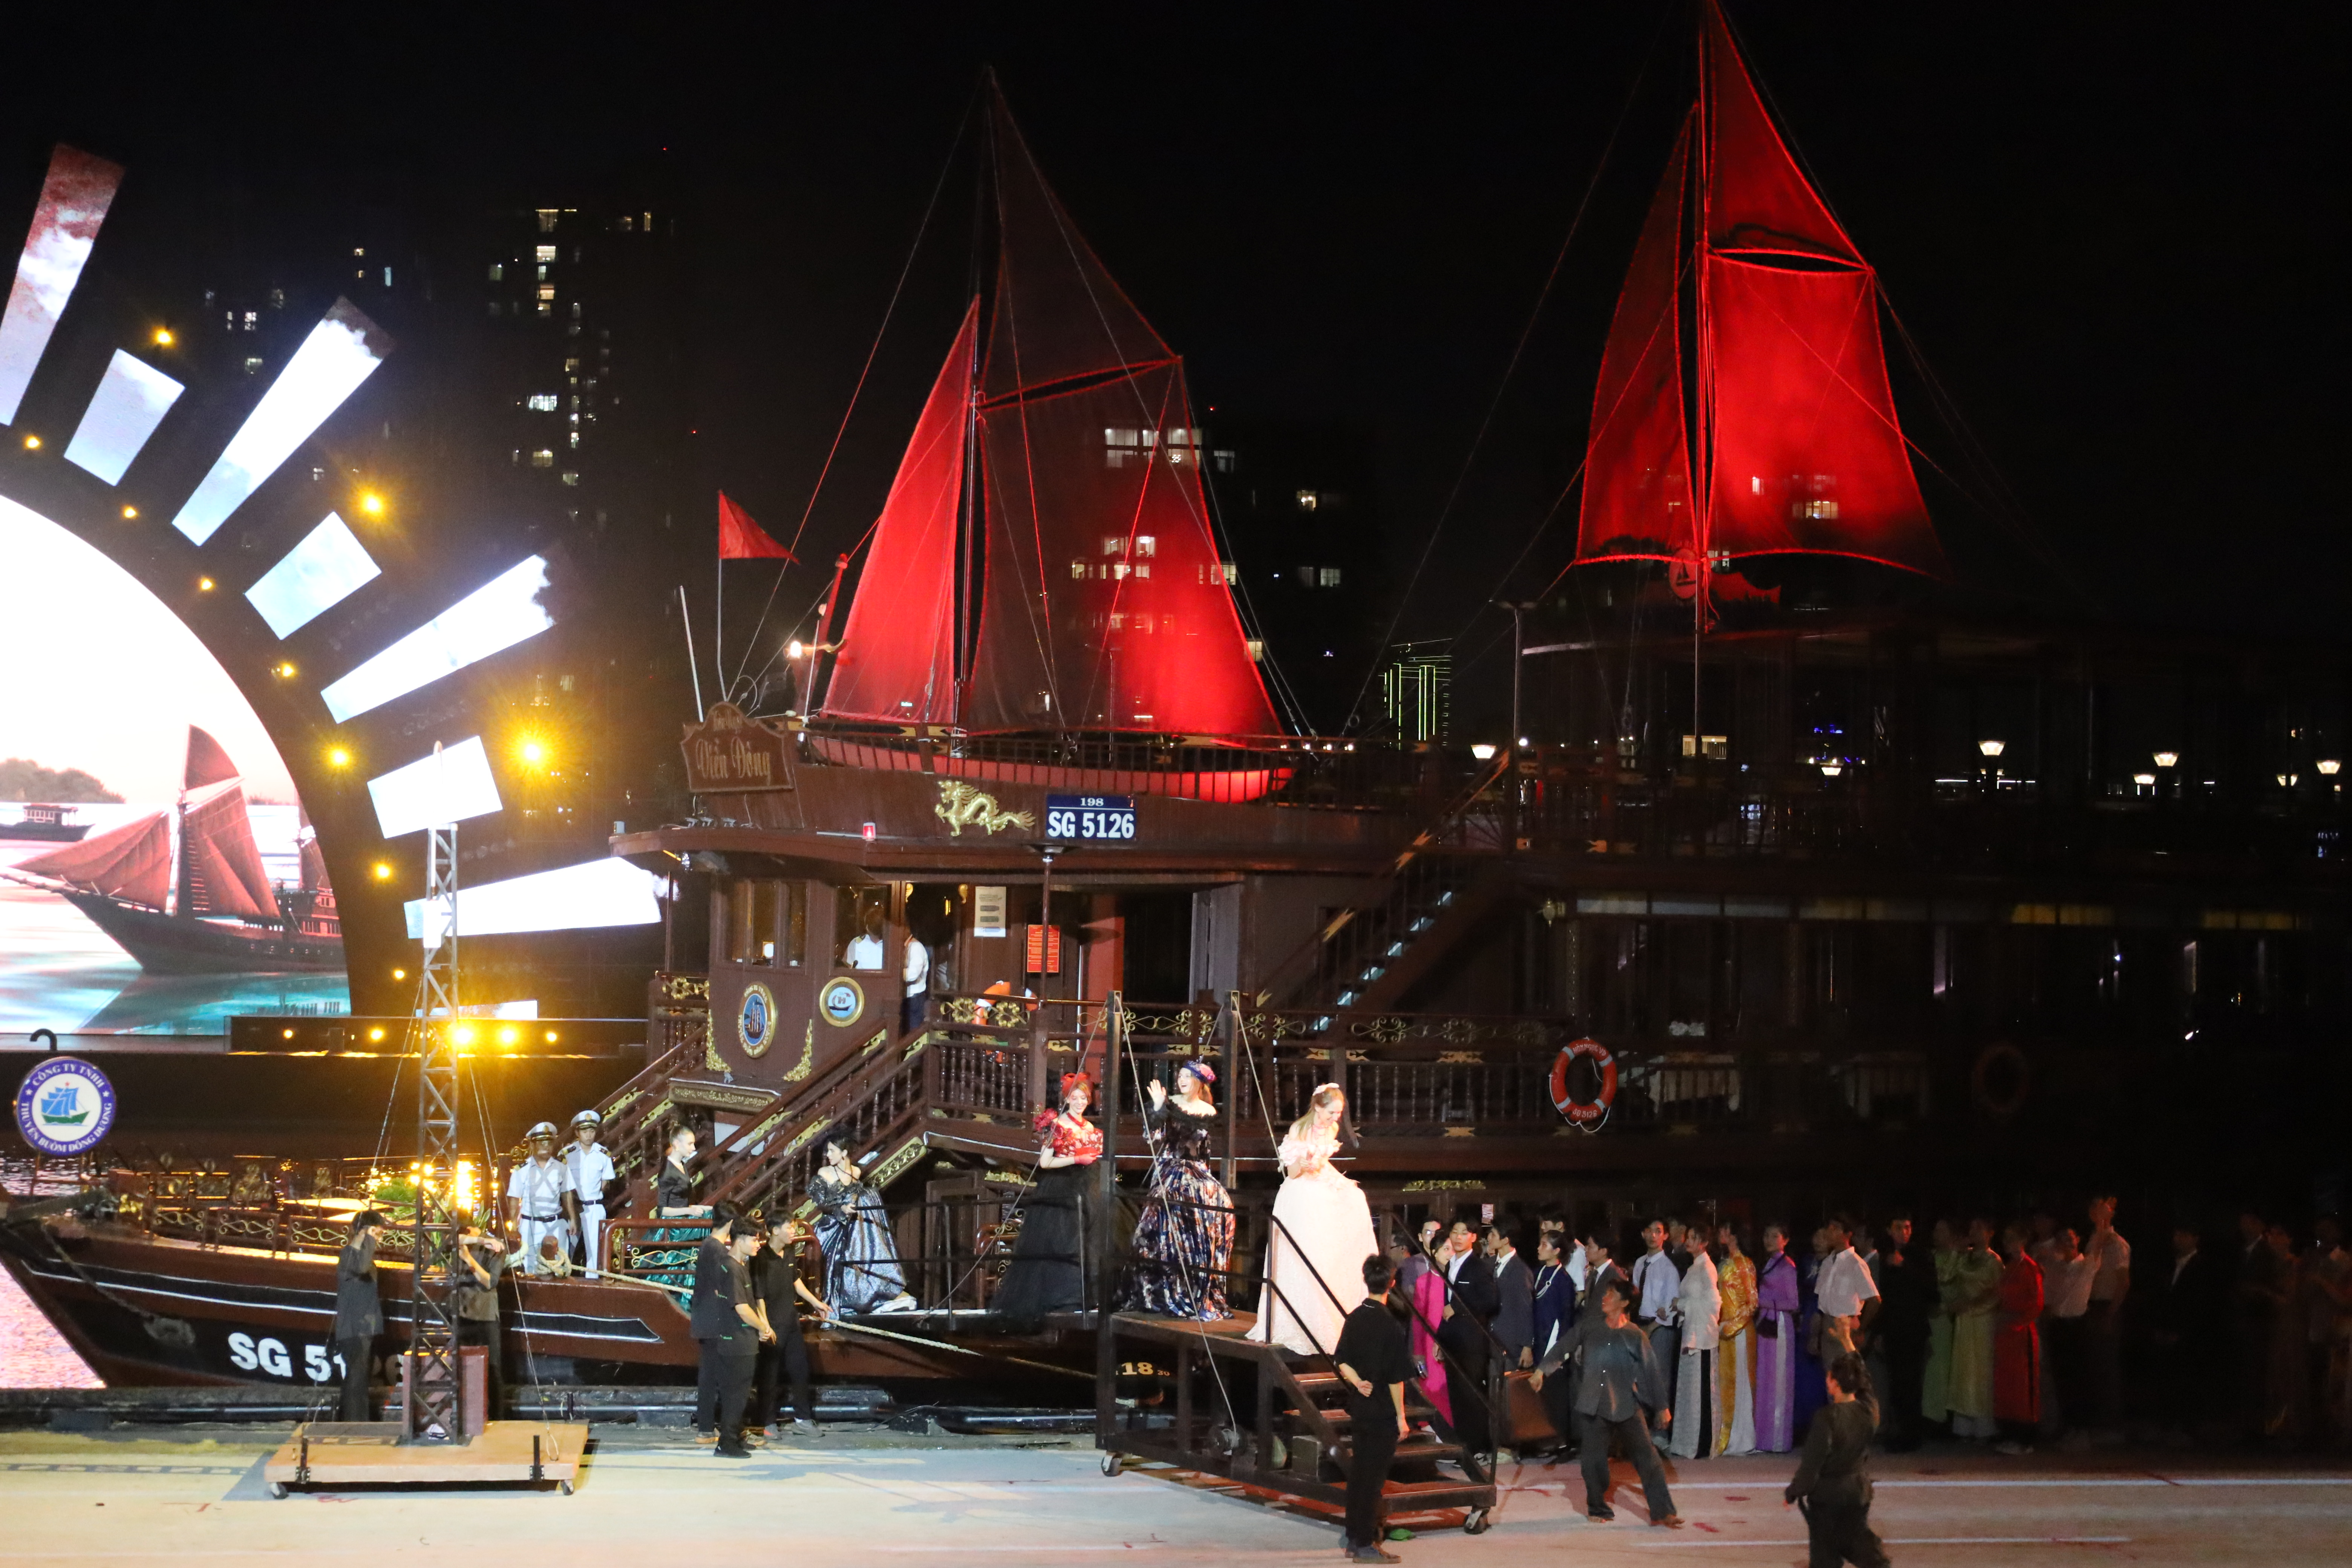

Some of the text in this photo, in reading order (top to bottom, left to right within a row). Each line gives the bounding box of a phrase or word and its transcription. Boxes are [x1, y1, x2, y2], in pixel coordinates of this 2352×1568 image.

[1081, 798, 1104, 806] 198
[1048, 812, 1135, 839] SG 5126
[32, 1063, 105, 1088] CÔNG TY TNHH
[1582, 1110, 1597, 1118] 5126
[68, 1136, 95, 1152] ĐÔNG
[228, 1332, 293, 1377] SG
[1121, 1362, 1153, 1375] 18
